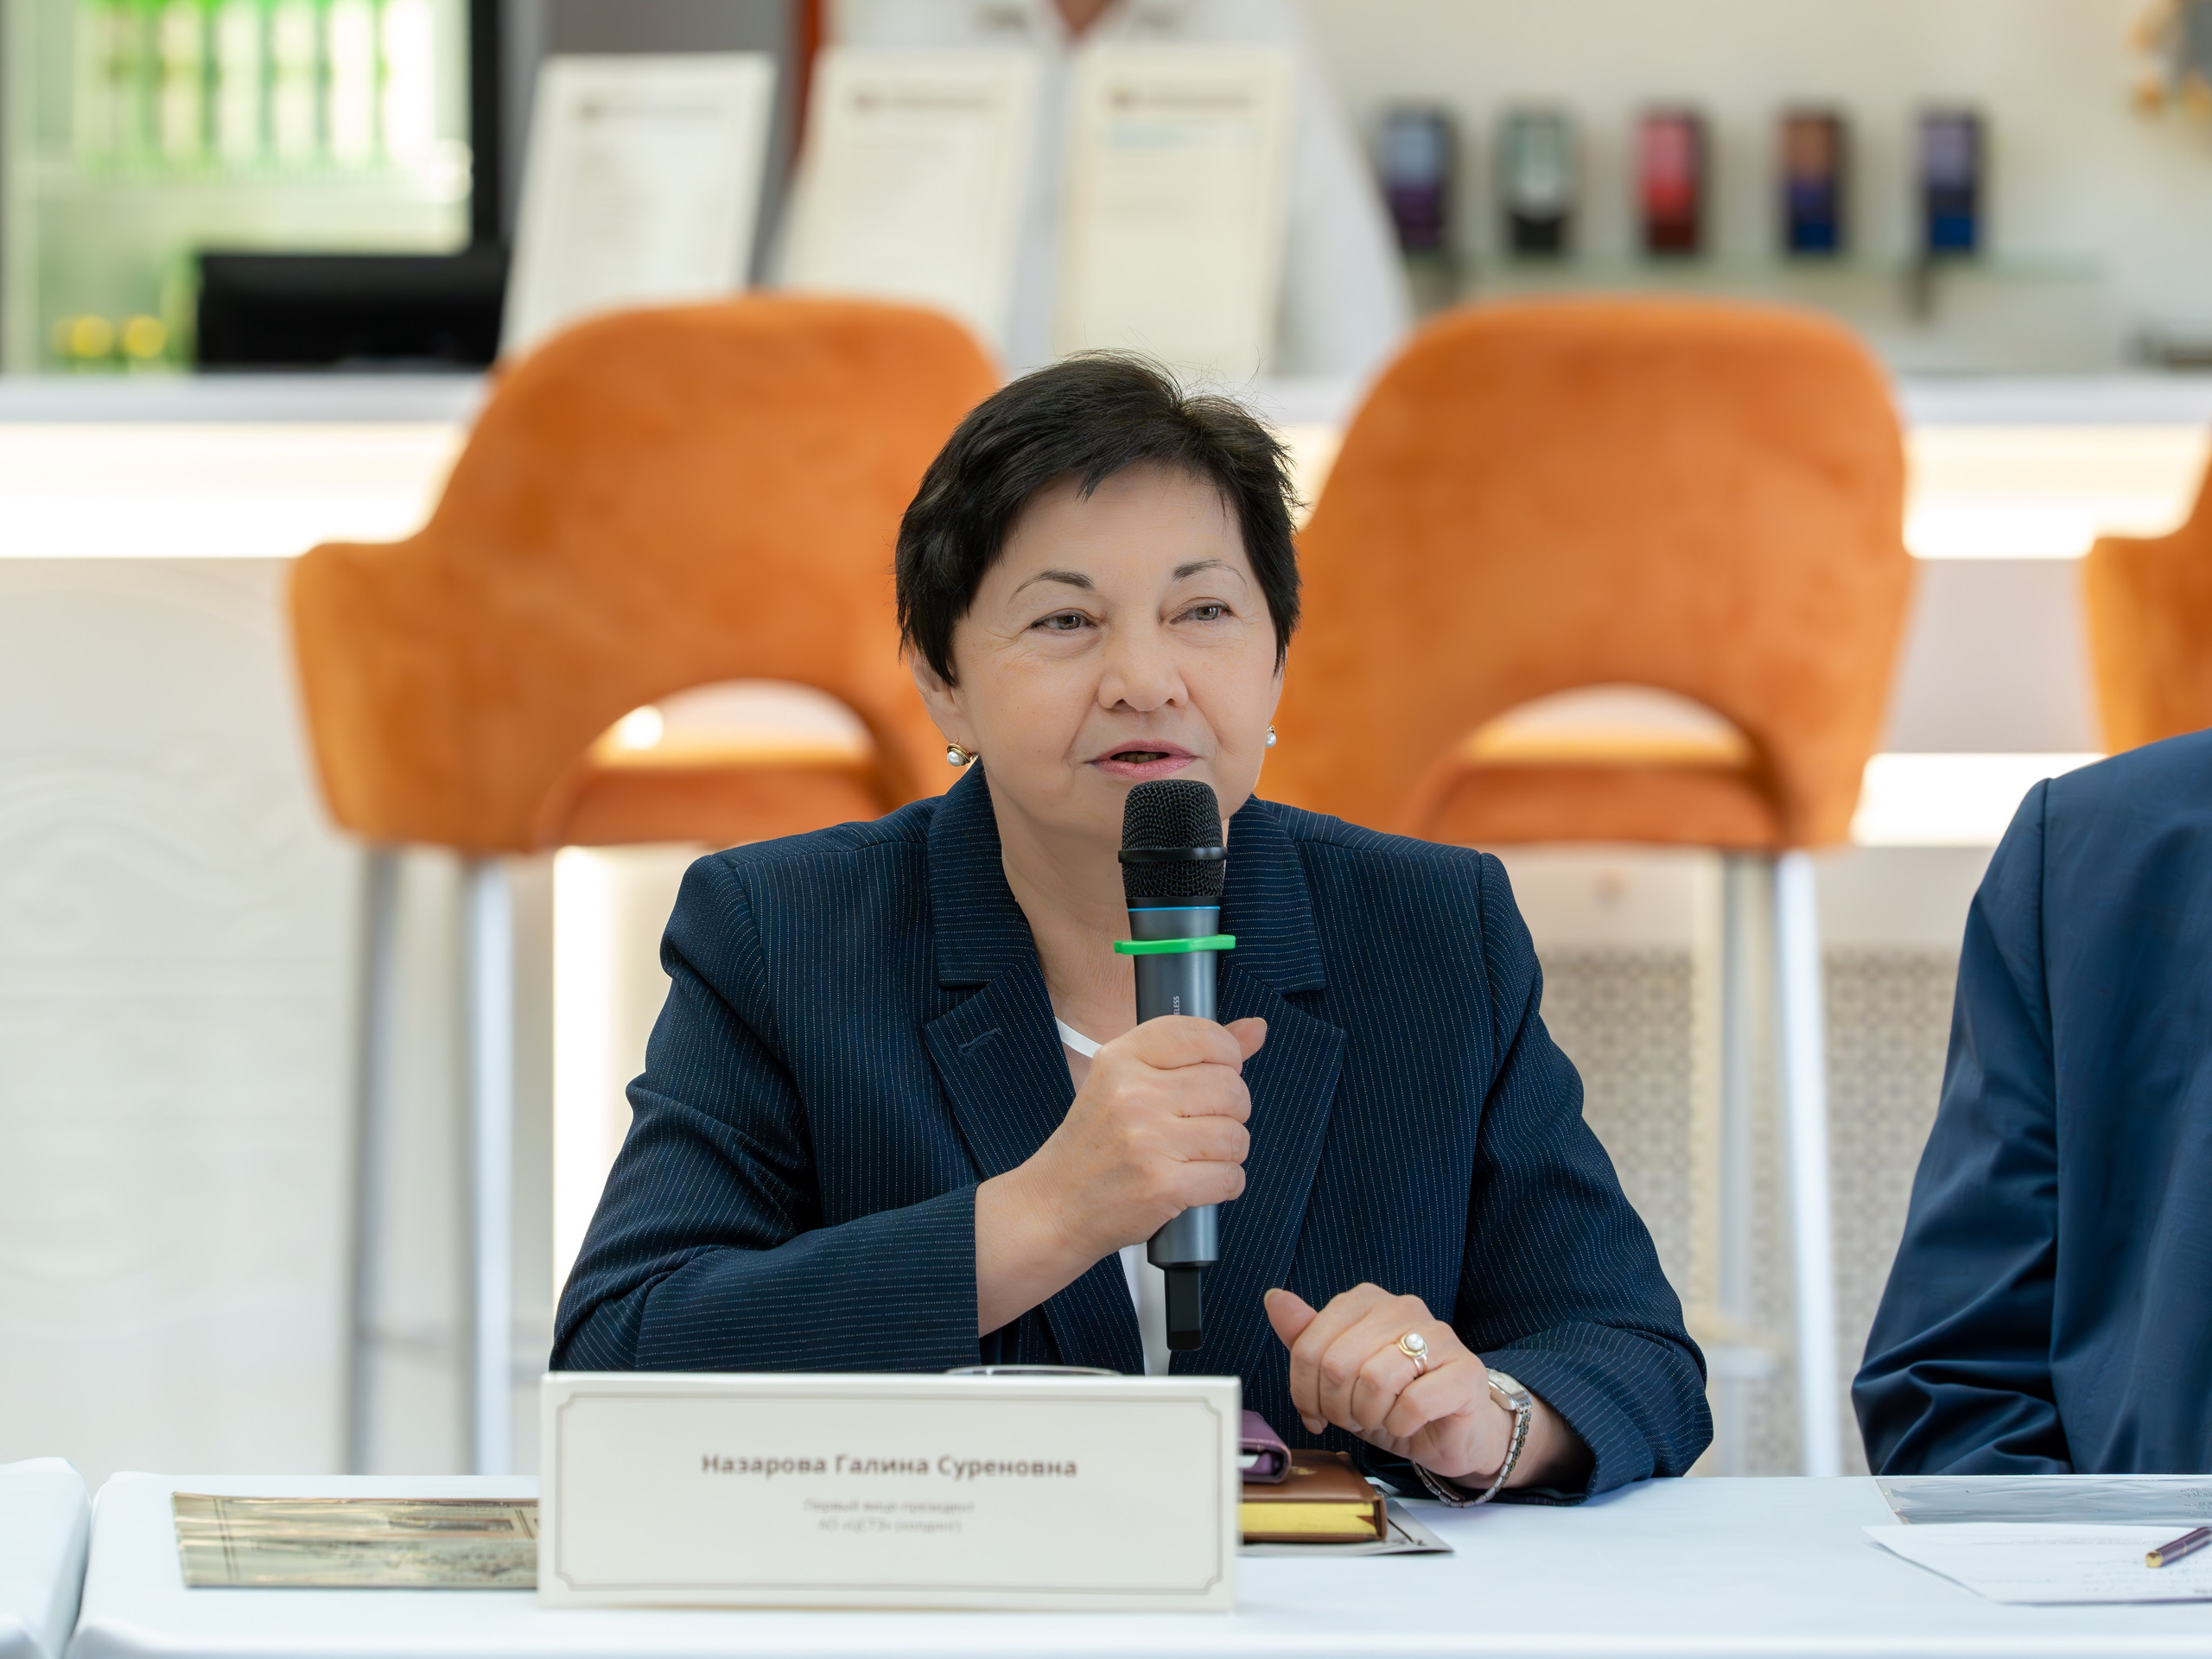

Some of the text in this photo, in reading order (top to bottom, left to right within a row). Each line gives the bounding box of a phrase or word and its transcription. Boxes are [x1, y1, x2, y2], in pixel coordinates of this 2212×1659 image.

[701, 1454, 1078, 1481] Назарова Галина Суреновна
